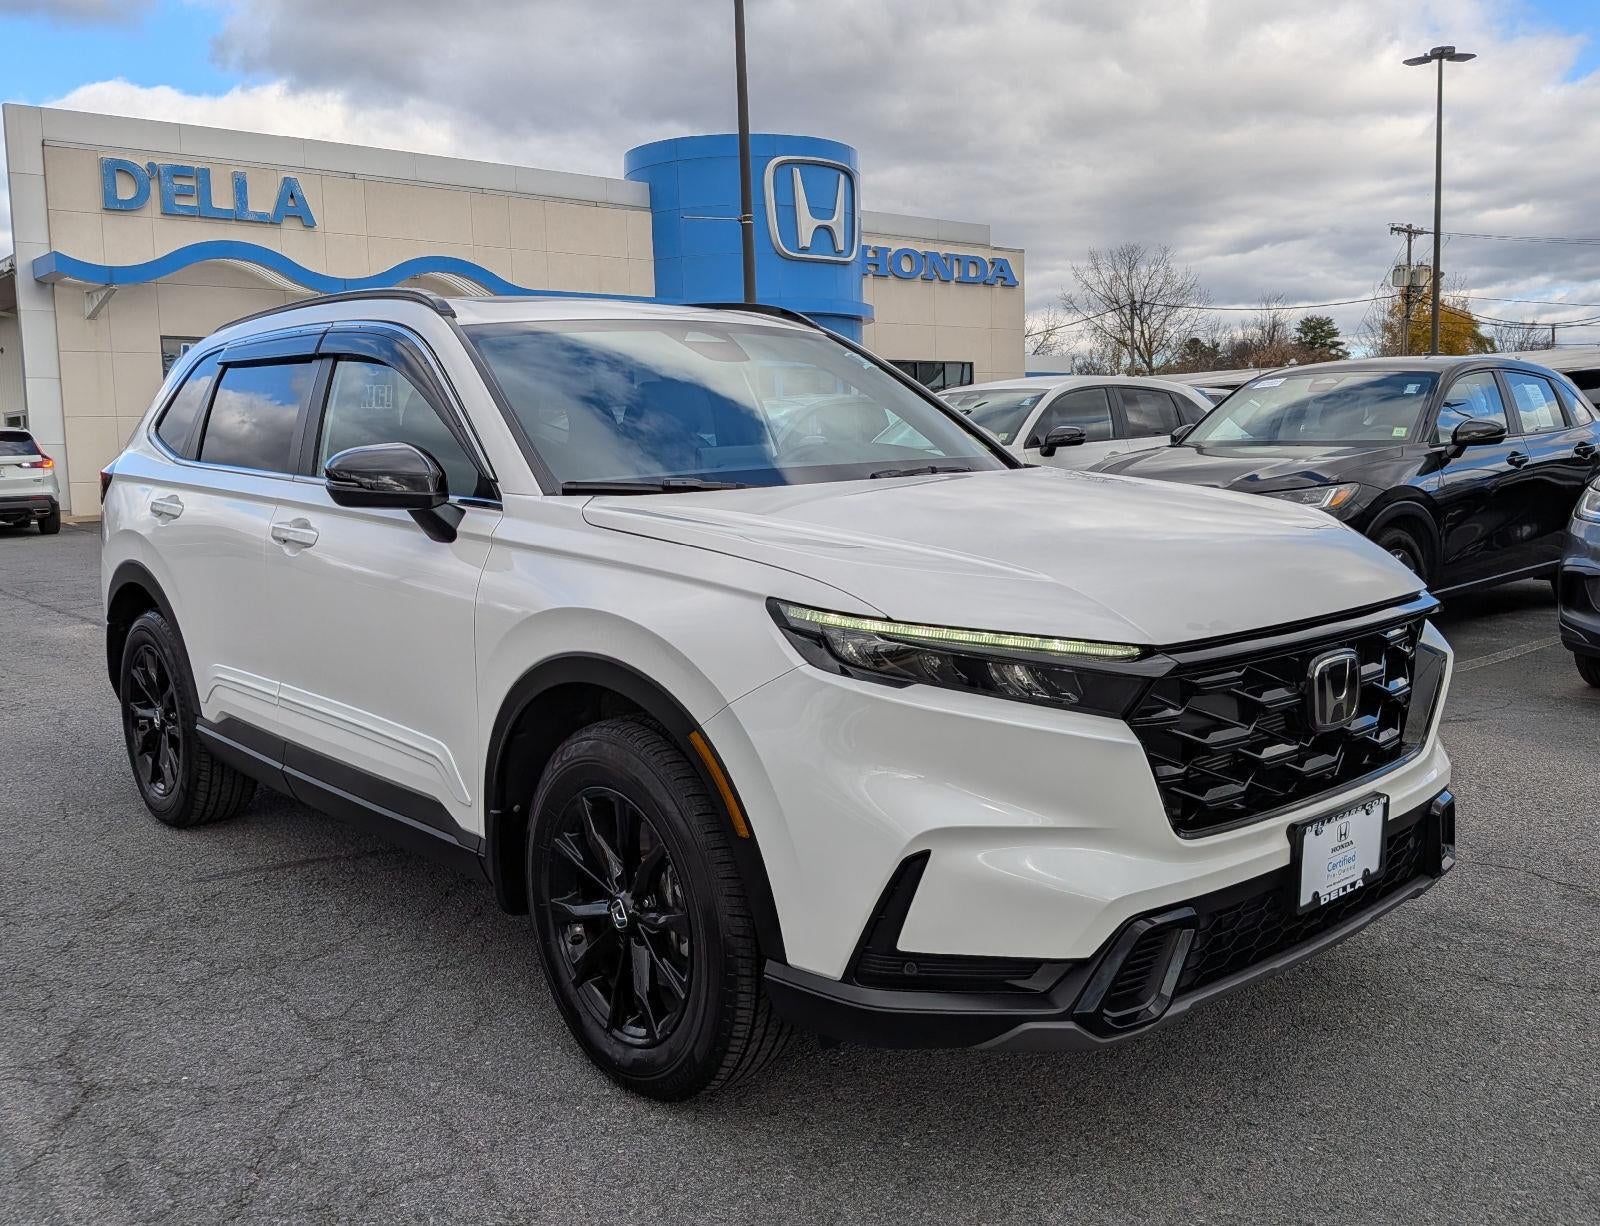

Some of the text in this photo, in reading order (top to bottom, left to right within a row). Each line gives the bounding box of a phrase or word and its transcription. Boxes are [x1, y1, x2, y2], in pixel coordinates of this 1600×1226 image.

[101, 157, 317, 228] D'ELLA
[862, 245, 1019, 287] HONDA
[1331, 840, 1354, 854] HONDA
[1327, 852, 1356, 873] Certified
[1320, 879, 1364, 906] DELLA
